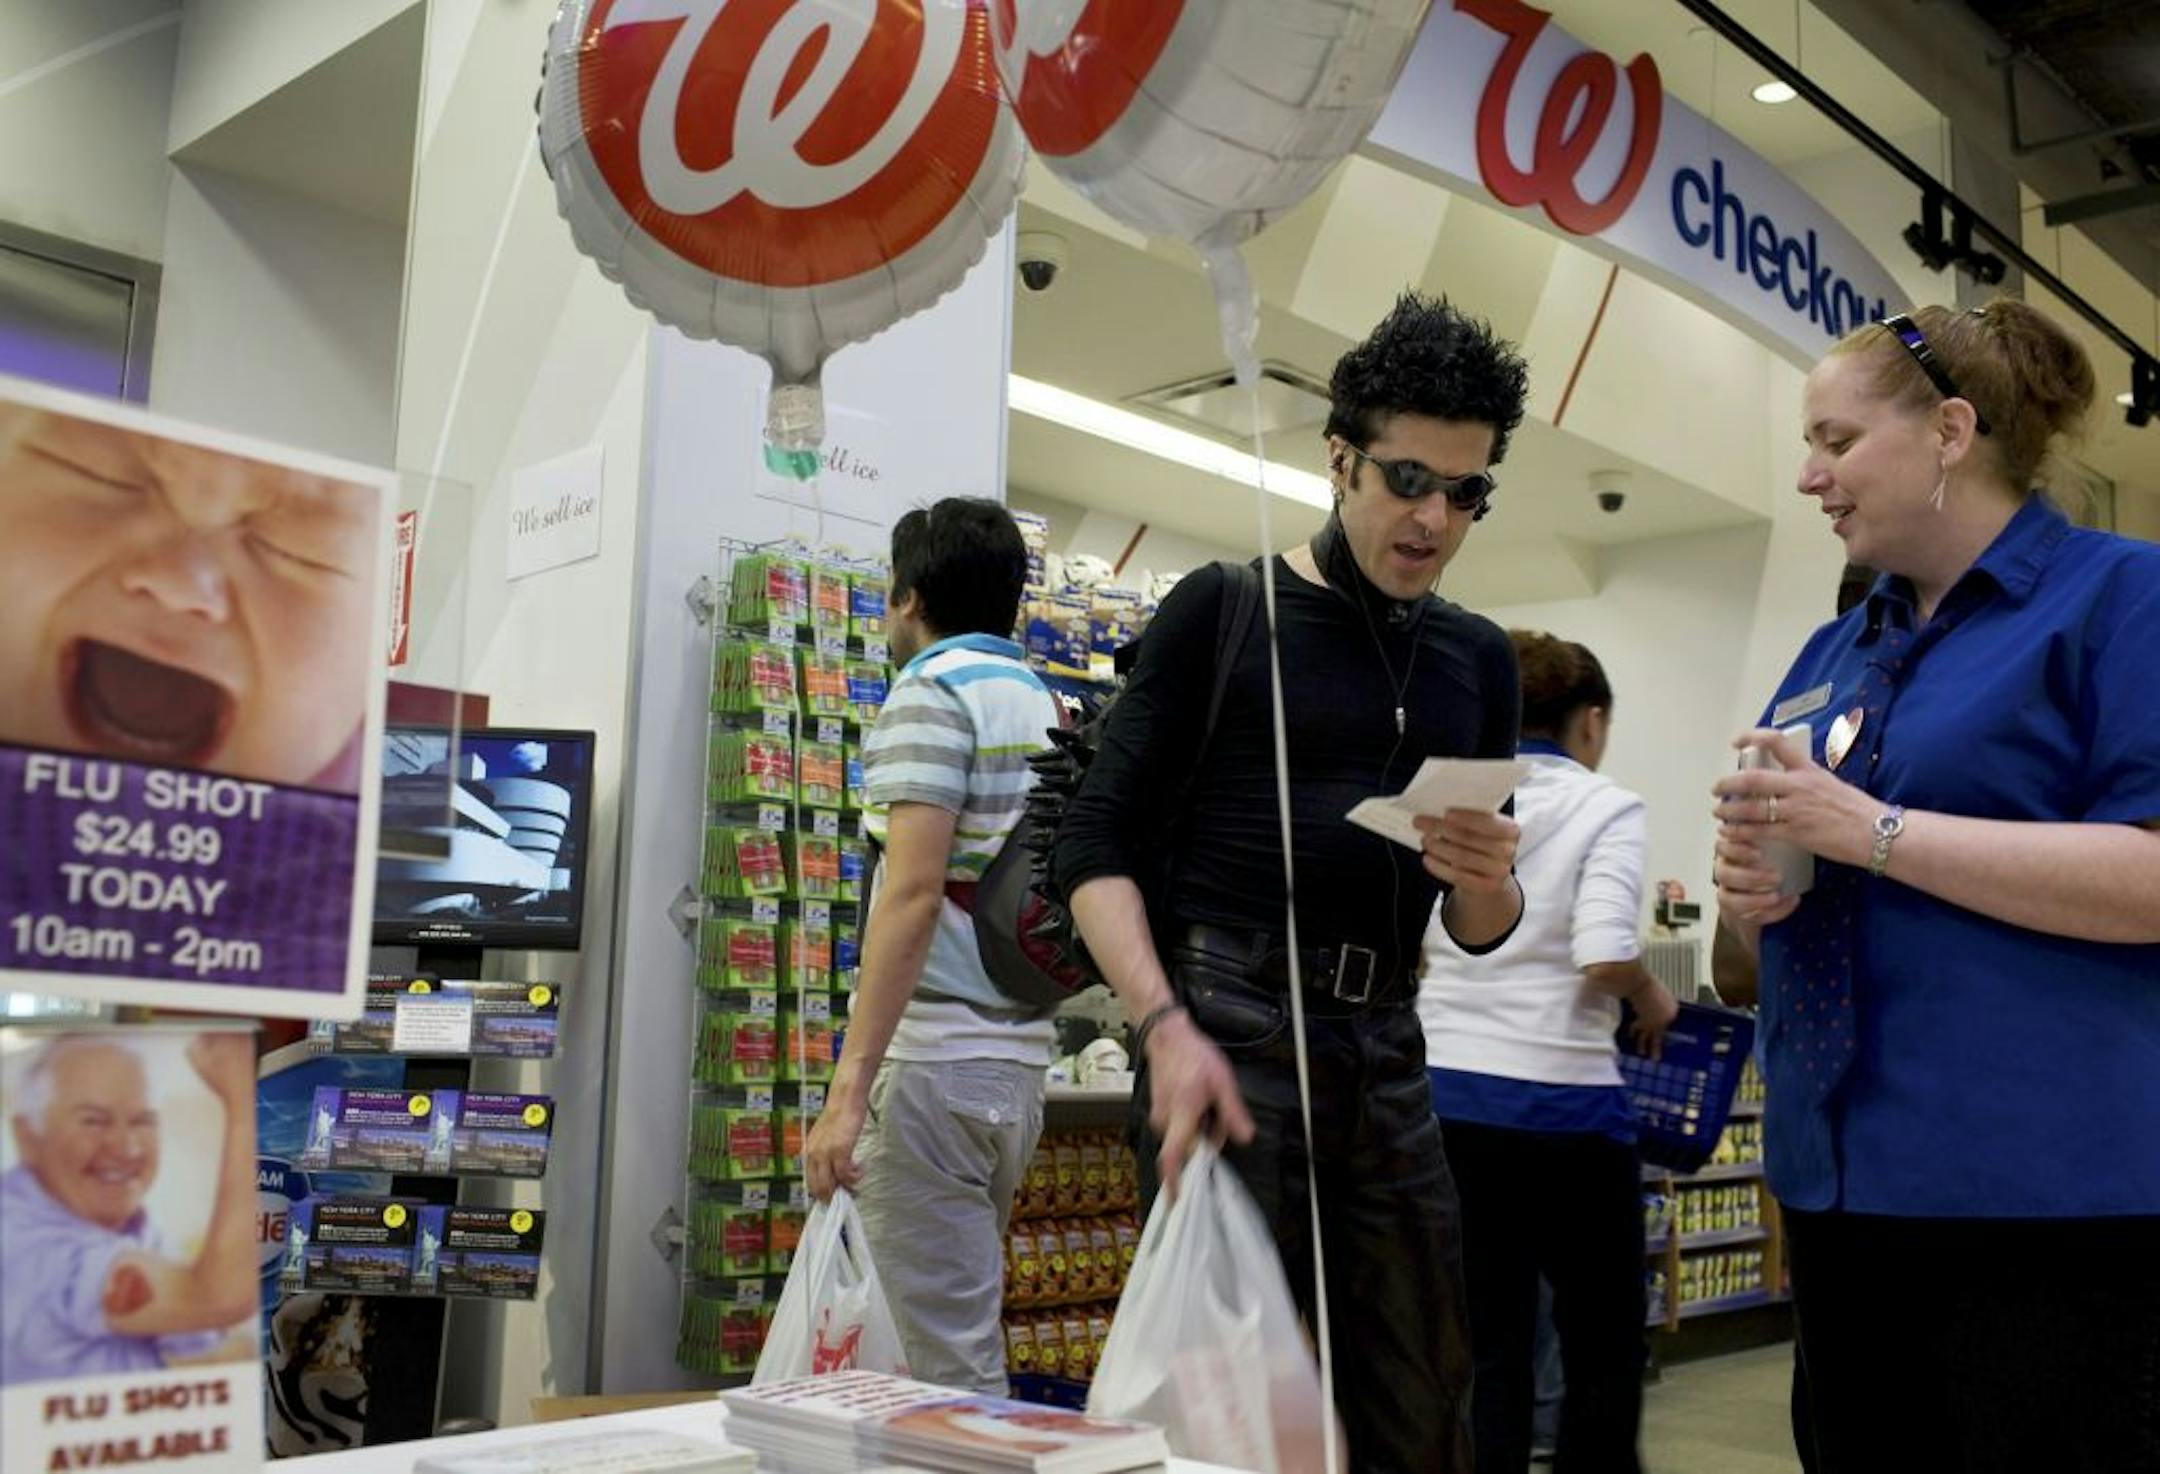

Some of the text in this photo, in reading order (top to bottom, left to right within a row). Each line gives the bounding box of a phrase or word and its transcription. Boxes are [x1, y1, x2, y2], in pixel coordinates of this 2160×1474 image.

[1671, 158, 1885, 340] checko
[24, 753, 274, 820] FLU SHOT
[73, 811, 222, 865] $24.99
[59, 863, 227, 916] TODAY
[11, 914, 134, 961] 10am
[171, 926, 262, 975] 2pm
[43, 1379, 229, 1424] FLU SHOTS
[48, 1425, 229, 1472] AVAILABLE
